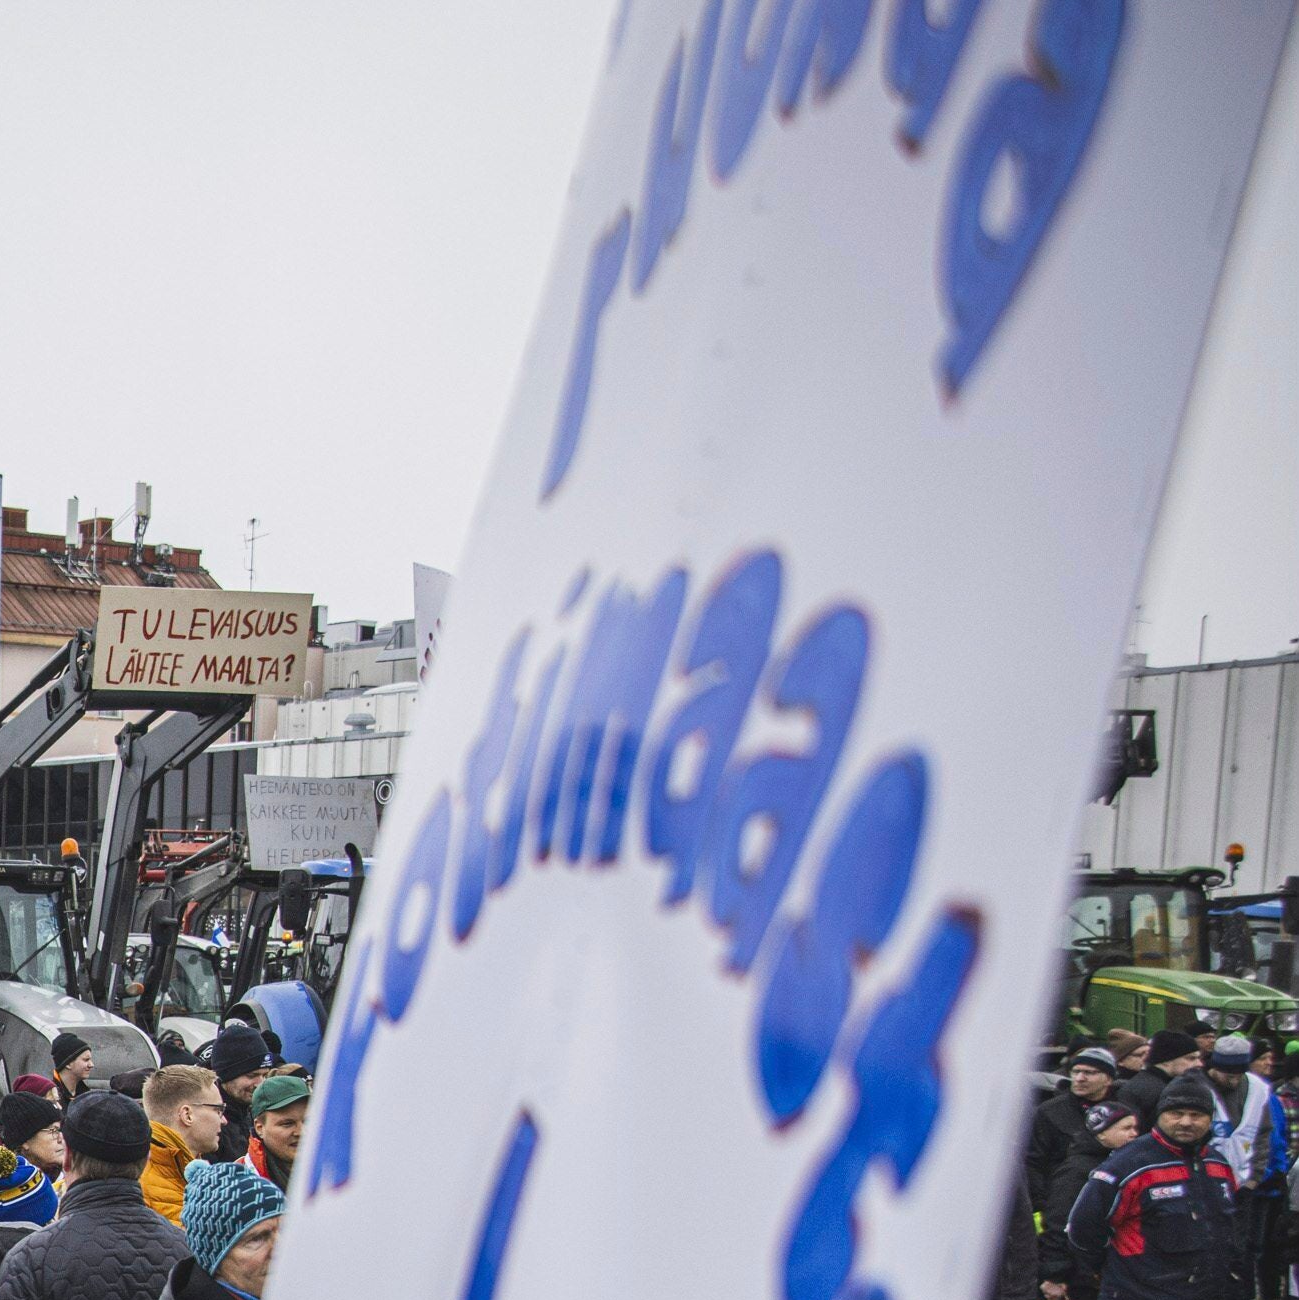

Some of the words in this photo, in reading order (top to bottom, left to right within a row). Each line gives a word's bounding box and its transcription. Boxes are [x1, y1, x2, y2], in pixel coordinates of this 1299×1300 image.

[113, 608, 299, 644] TULEVAISUUS
[105, 645, 186, 687] LÄHTEE
[191, 654, 297, 687] MAALTA?
[290, 824, 337, 841] KUIN
